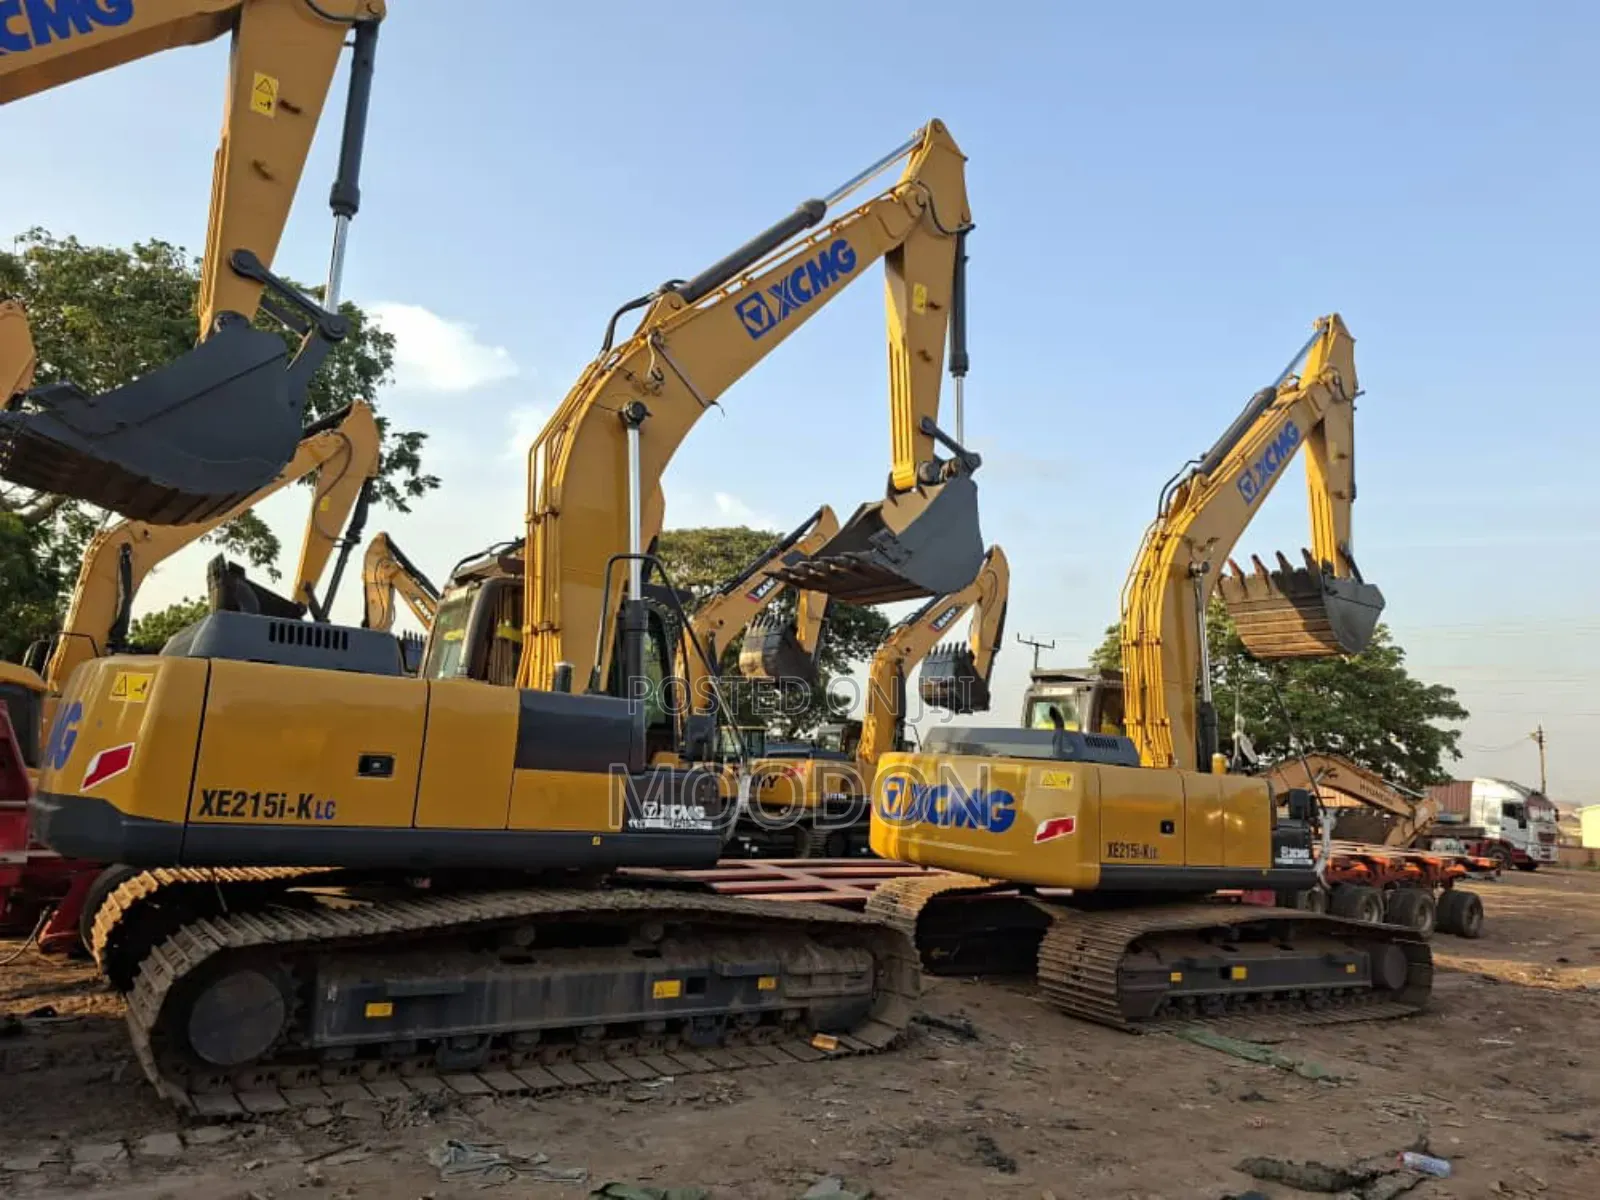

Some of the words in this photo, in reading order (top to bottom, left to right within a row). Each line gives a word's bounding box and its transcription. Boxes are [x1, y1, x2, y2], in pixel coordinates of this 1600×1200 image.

[0, 0, 134, 56] CMG
[767, 238, 858, 322] XCMG
[1254, 420, 1299, 487] XCMG
[905, 783, 1017, 833] XCMG
